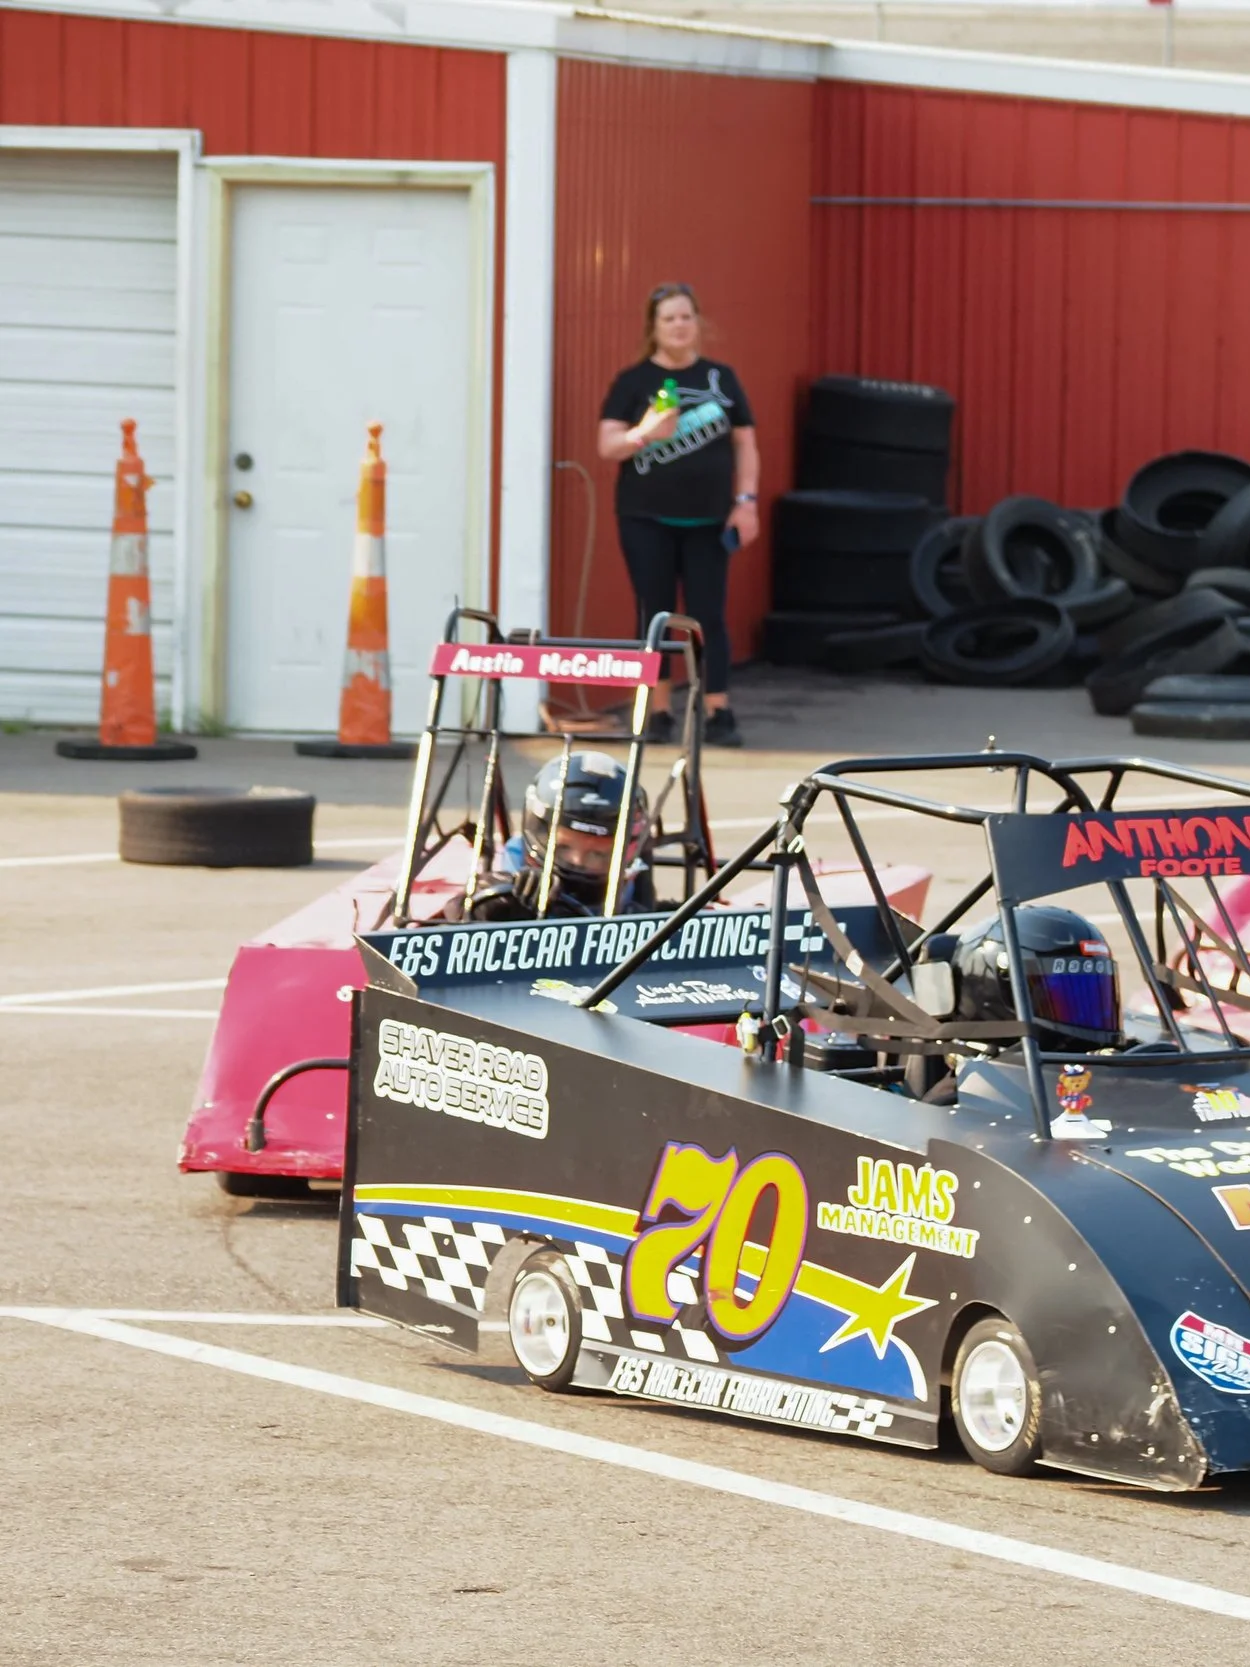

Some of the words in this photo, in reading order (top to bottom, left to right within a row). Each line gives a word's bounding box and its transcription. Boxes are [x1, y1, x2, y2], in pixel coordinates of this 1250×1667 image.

[450, 648, 524, 673] Austin
[1140, 857, 1243, 877] FOOTE
[446, 925, 578, 975] RACECAR
[380, 1021, 477, 1077] SHAVER
[477, 1045, 545, 1092] ROAD
[376, 1059, 443, 1103] AUTO
[444, 1075, 546, 1132] SERVICE
[1125, 1147, 1213, 1162] The
[848, 1156, 959, 1225] JAMS
[626, 1141, 809, 1341] 70
[817, 1202, 980, 1258] MANAGEMENT
[643, 1361, 729, 1407] RACECAR
[722, 1375, 838, 1427] FABRICATING
